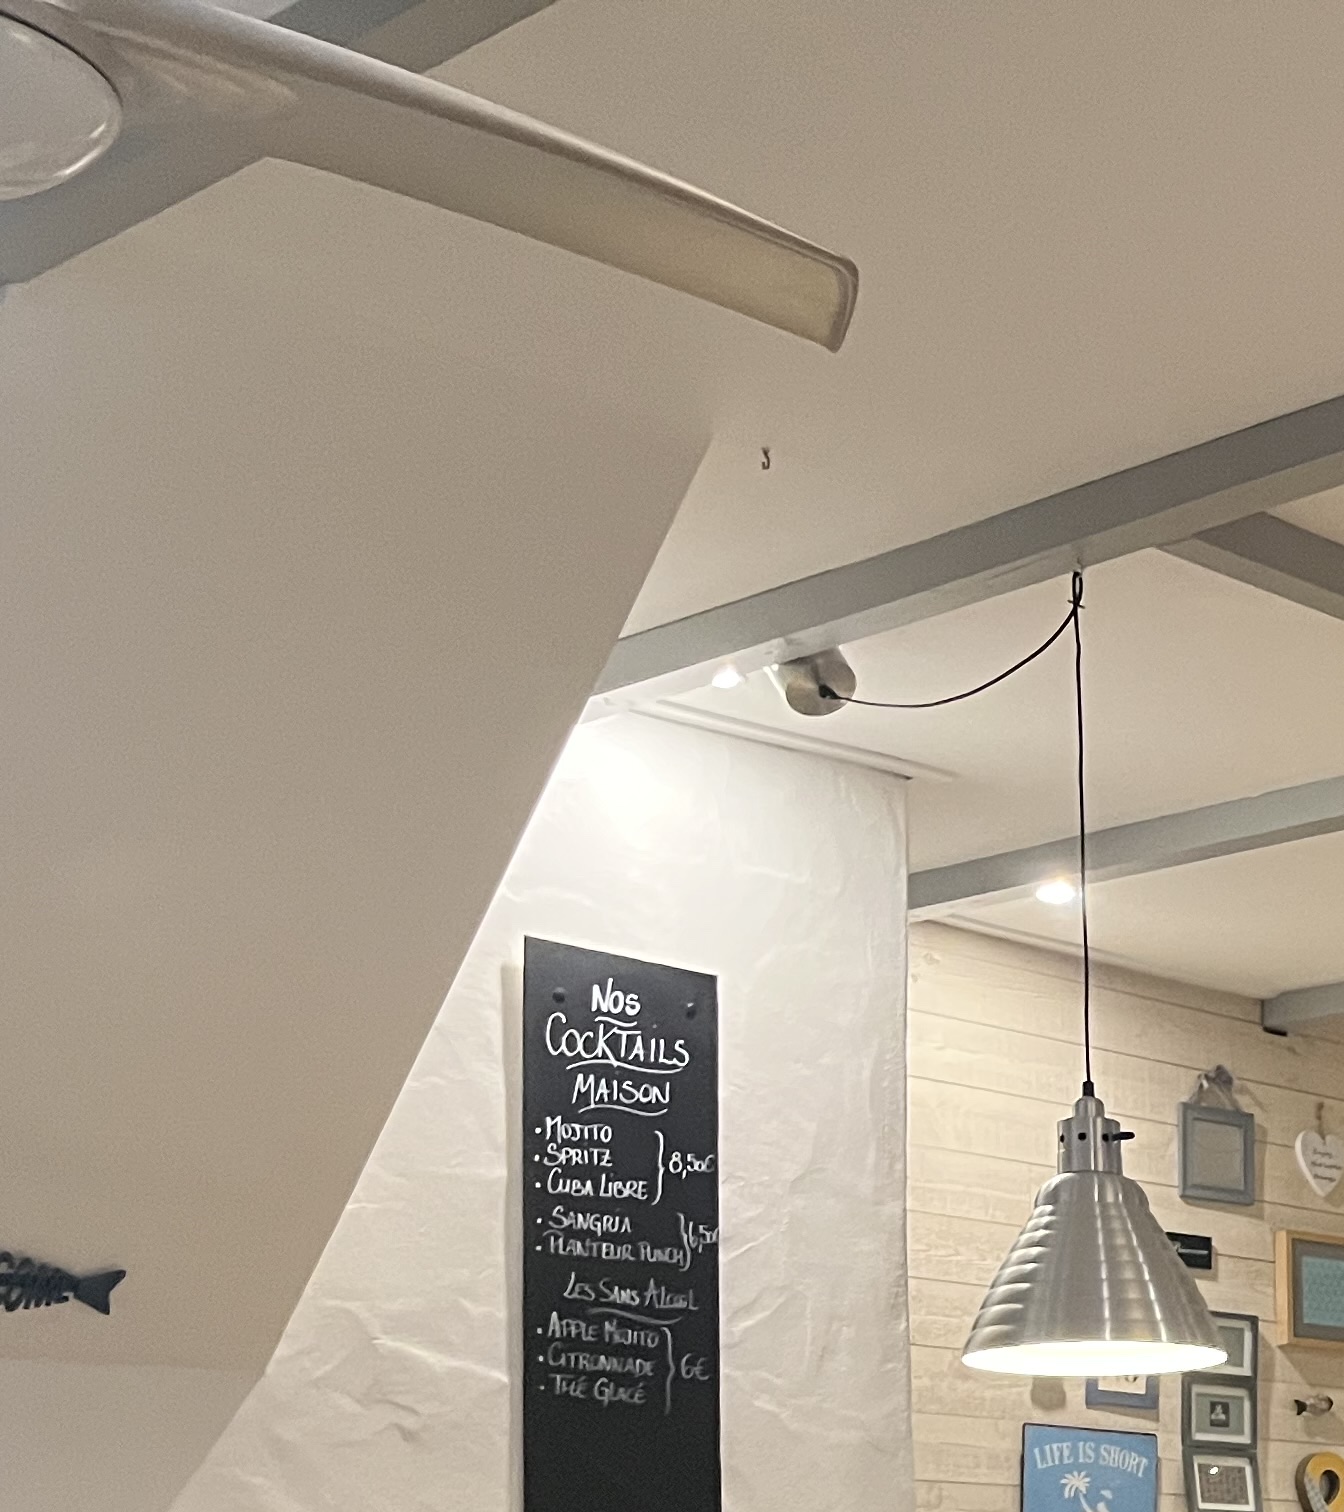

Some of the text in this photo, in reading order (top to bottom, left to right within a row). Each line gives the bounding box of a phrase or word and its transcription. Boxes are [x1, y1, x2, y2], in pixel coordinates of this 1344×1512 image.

[571, 1073, 671, 1107] MAISON
[545, 1115, 613, 1144] MOJITO
[543, 1143, 613, 1166] SPRITZ
[547, 1166, 594, 1197] CUBA
[549, 1205, 632, 1237] SANGRIA
[547, 1311, 599, 1341] APPLE
[680, 1353, 710, 1381] 6€
[1033, 1440, 1149, 1478] LIFE IS SHORT
